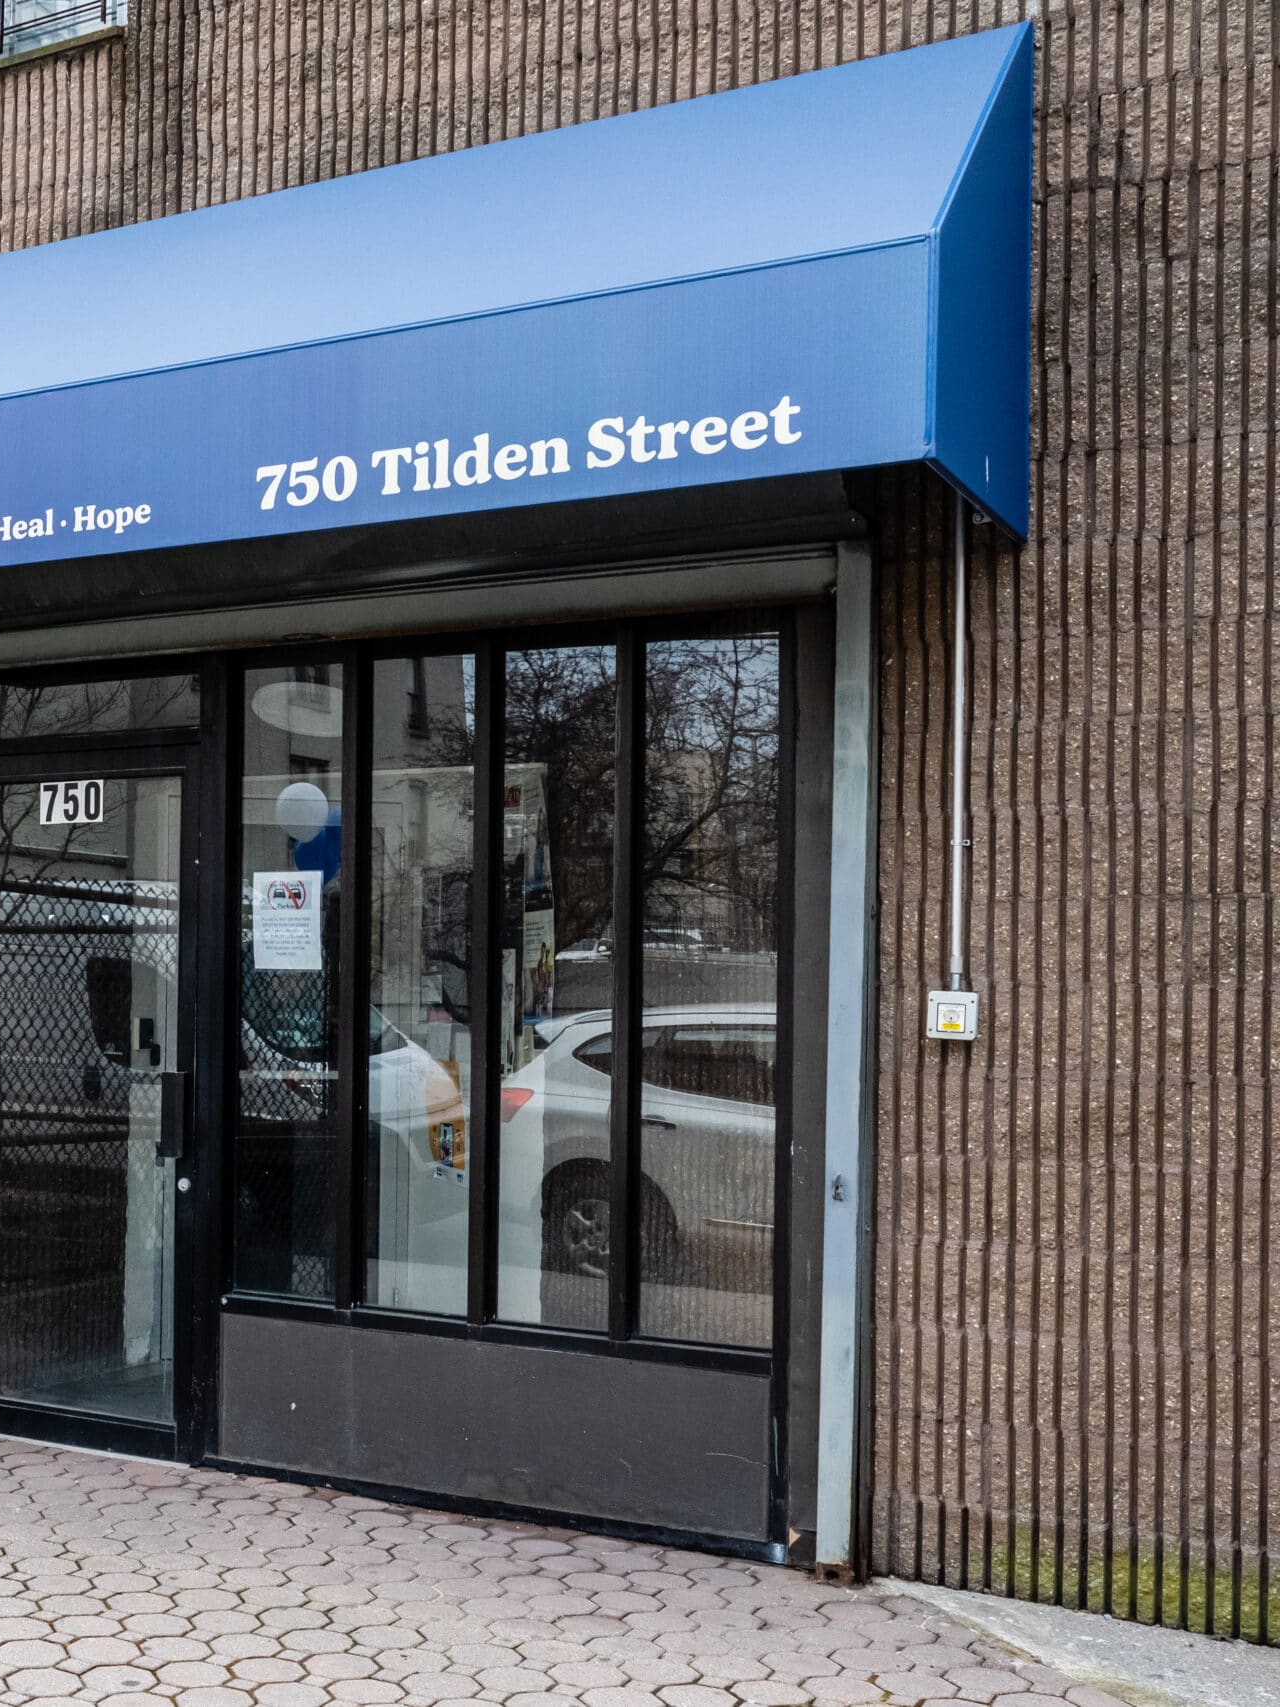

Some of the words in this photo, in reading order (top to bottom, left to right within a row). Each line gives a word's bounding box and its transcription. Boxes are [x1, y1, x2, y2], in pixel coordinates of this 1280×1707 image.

[255, 455, 358, 511] 750
[371, 432, 571, 496] Tilden
[586, 395, 802, 470] Street
[73, 503, 152, 535] Hope
[42, 781, 101, 823] 750
